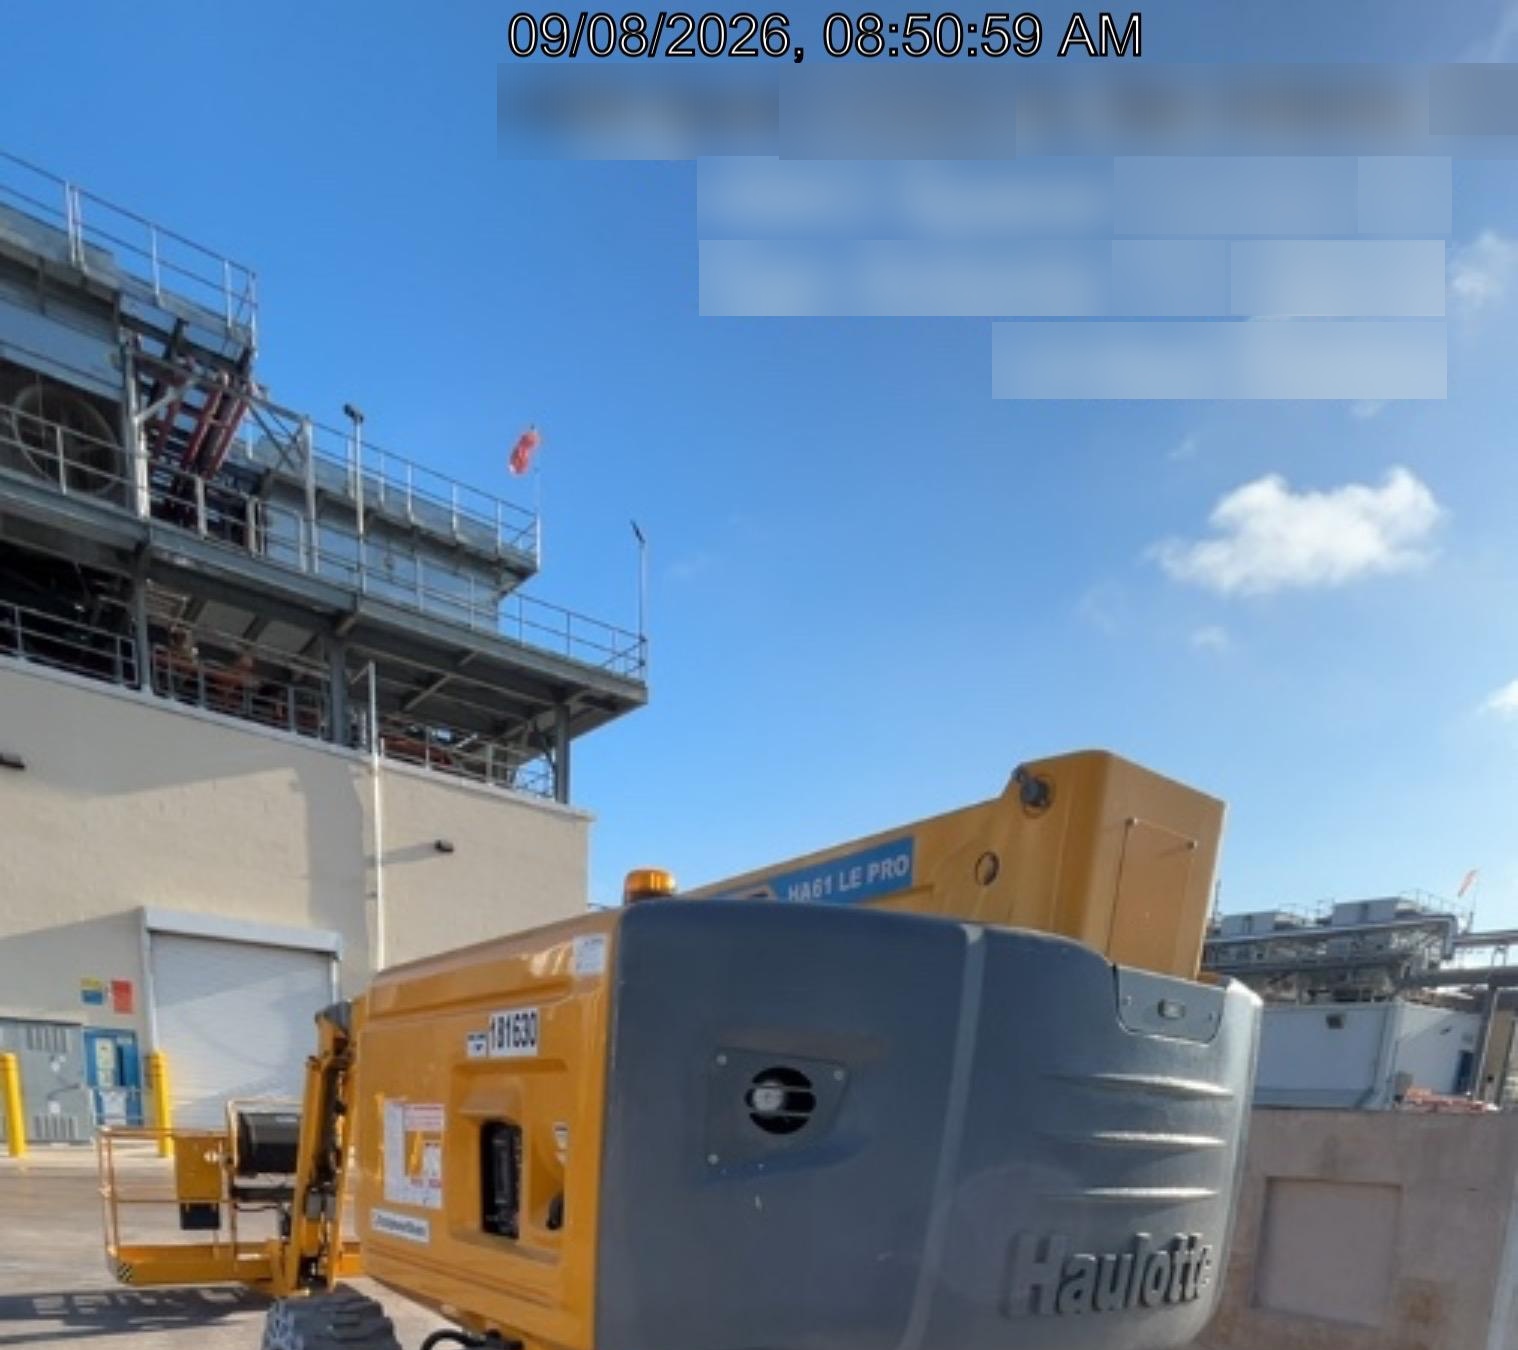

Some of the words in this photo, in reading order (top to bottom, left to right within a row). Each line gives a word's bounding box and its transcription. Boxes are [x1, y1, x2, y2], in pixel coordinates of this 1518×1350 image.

[788, 874, 833, 902] HA61
[838, 866, 863, 892] LE
[866, 854, 910, 883] PRO
